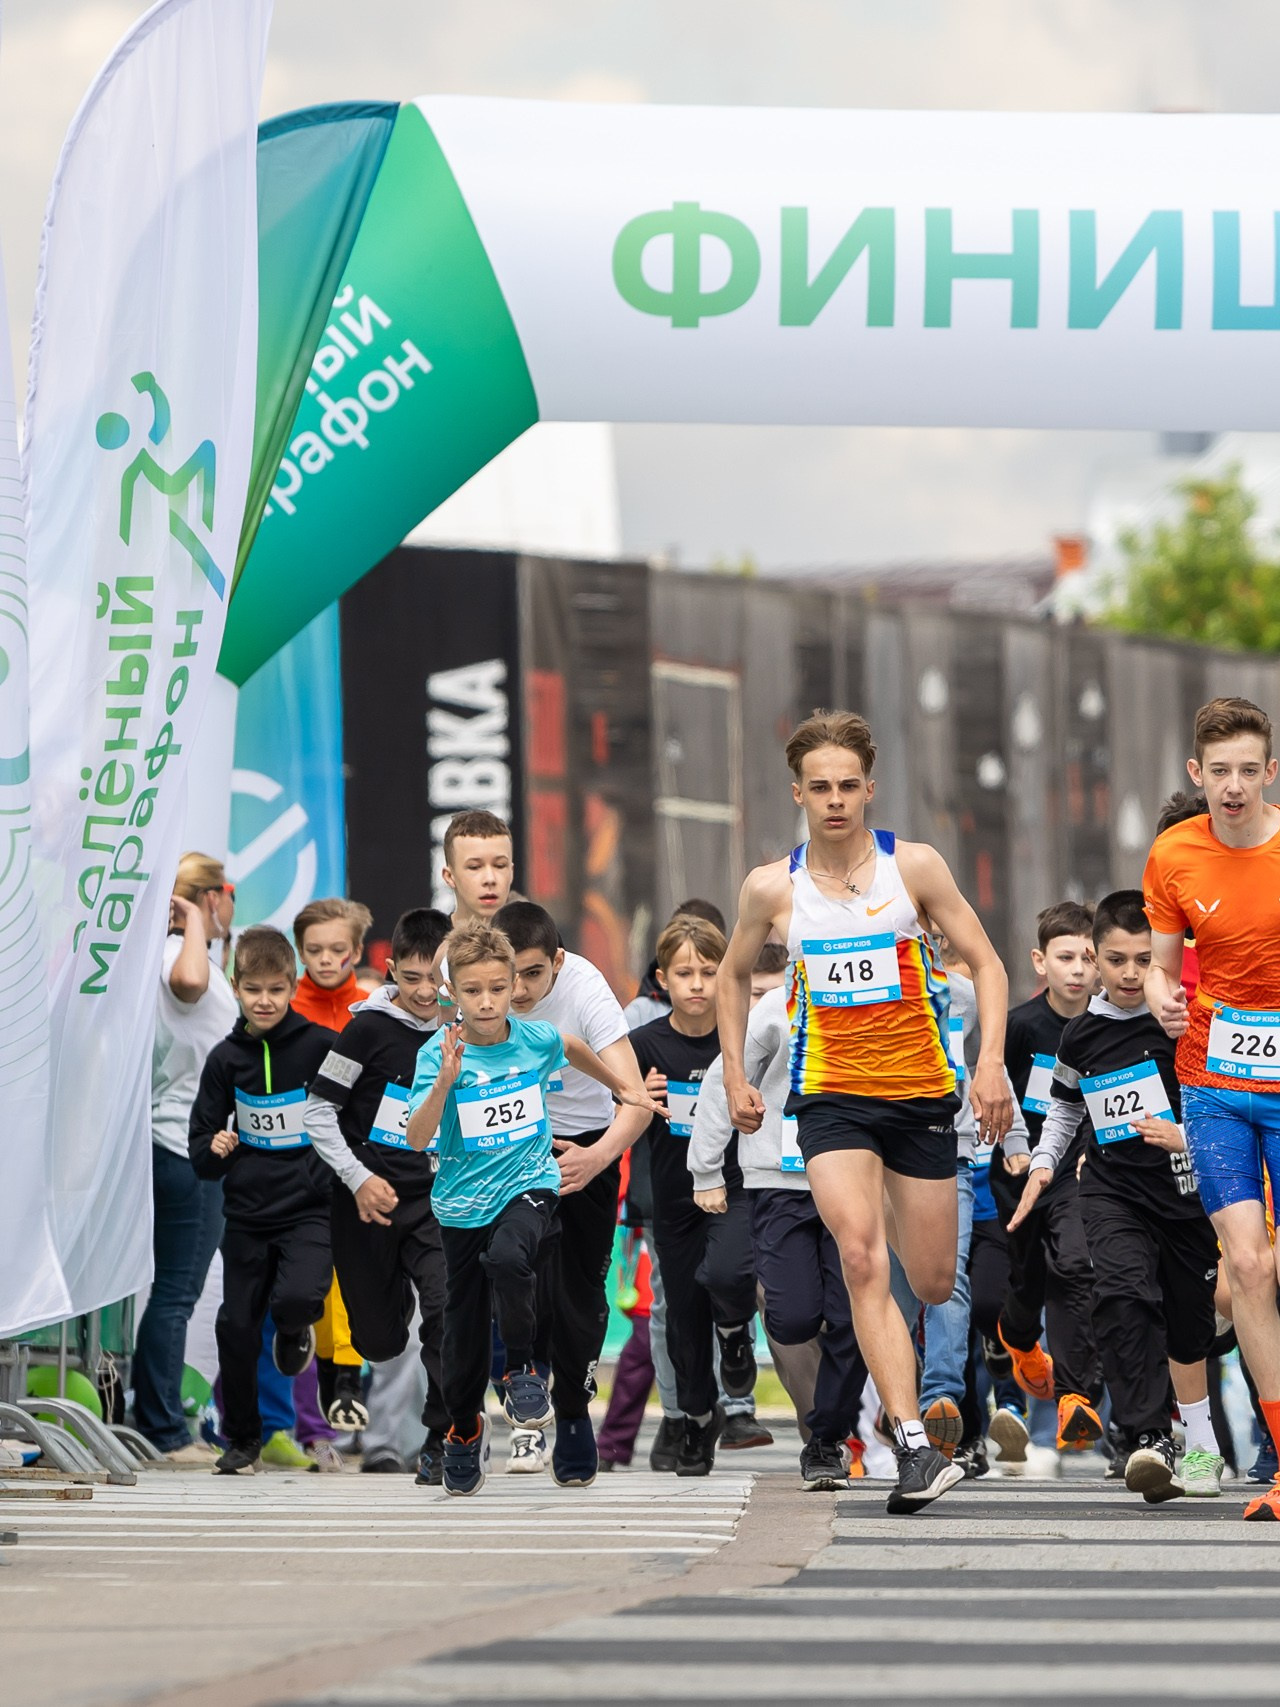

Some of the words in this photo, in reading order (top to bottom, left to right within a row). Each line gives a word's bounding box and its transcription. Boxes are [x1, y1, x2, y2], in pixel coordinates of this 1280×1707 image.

[261, 338, 434, 518] рафон
[79, 609, 204, 995] марафон
[832, 941, 852, 950] СБЕР
[853, 939, 872, 948] KIDS
[827, 959, 874, 985] 418
[1240, 1014, 1262, 1023] СБЕР
[1262, 1014, 1280, 1023] KIDS
[1230, 1032, 1277, 1058] 226
[488, 1085, 507, 1095] СБЕР
[507, 1080, 523, 1090] KIDS
[1101, 1076, 1118, 1087] СБЕР
[1117, 1071, 1135, 1082] KIDS
[483, 1099, 526, 1128] 252
[1104, 1090, 1144, 1118] 422
[249, 1112, 286, 1131] 331
[382, 1132, 400, 1144] 420
